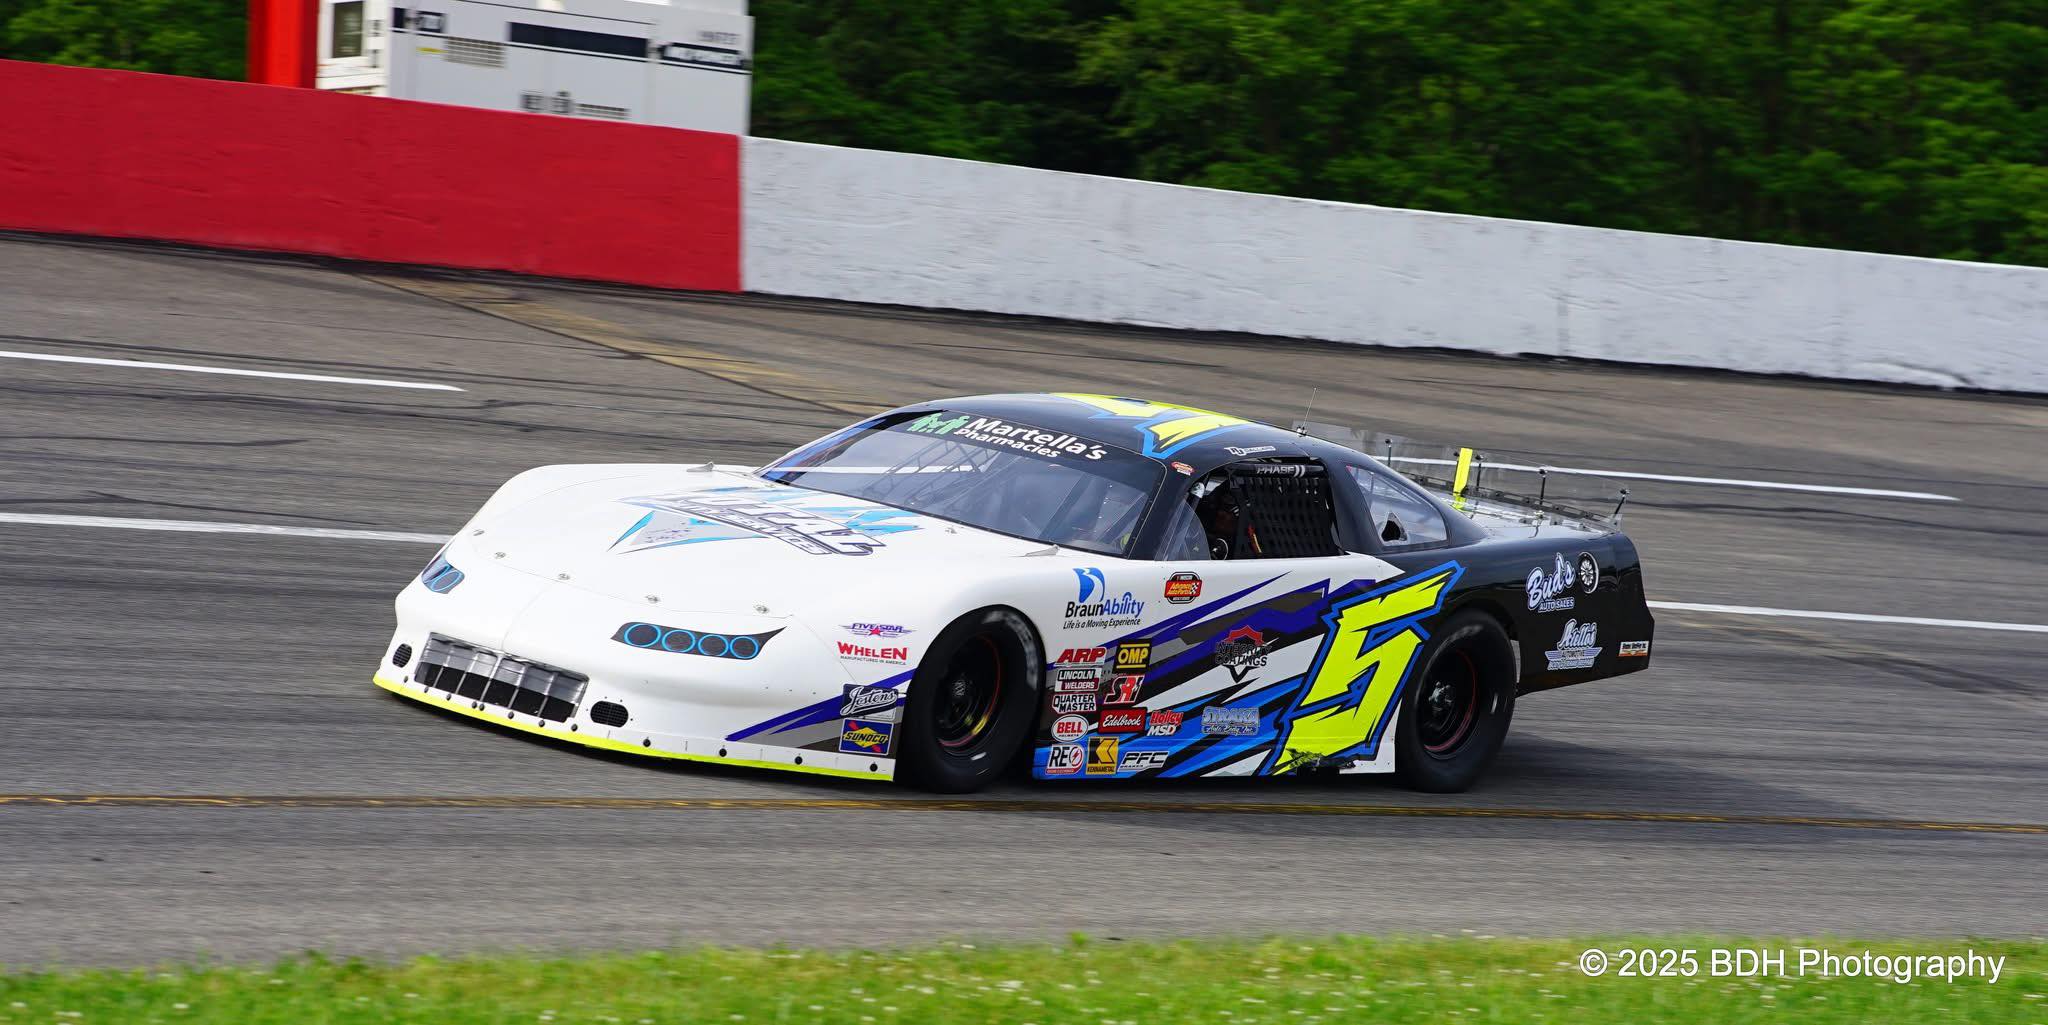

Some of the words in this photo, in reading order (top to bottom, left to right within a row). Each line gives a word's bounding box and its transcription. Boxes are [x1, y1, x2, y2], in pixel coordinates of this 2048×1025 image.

[953, 427, 1062, 458] Pharmacies
[964, 417, 1107, 460] Martella's
[1528, 553, 1574, 609] Bud's
[1065, 592, 1145, 618] BraunAbility
[1540, 601, 1556, 611] AUTO
[1556, 599, 1574, 609] SALES
[879, 625, 903, 633] STAR
[1063, 620, 1074, 629] Life
[1075, 620, 1081, 628] is
[1086, 619, 1107, 629] Moving
[1109, 617, 1141, 628] Experience
[837, 641, 907, 660] WHELEN
[1056, 648, 1106, 663] ARP
[1118, 648, 1149, 664] OMP
[1059, 669, 1094, 680] LINCOLN
[1272, 566, 1455, 776] 5
[1064, 681, 1095, 690] WELDERS
[840, 686, 898, 715] Jostens
[1053, 694, 1094, 708] QUARTER
[1059, 702, 1095, 712] MASTER
[1102, 714, 1141, 728] Edelbrock
[1150, 711, 1183, 726] Holley
[1056, 721, 1083, 733] BELL
[1147, 725, 1177, 736] MSD
[844, 732, 888, 743] SUNOCO
[1122, 751, 1169, 765] PFC
